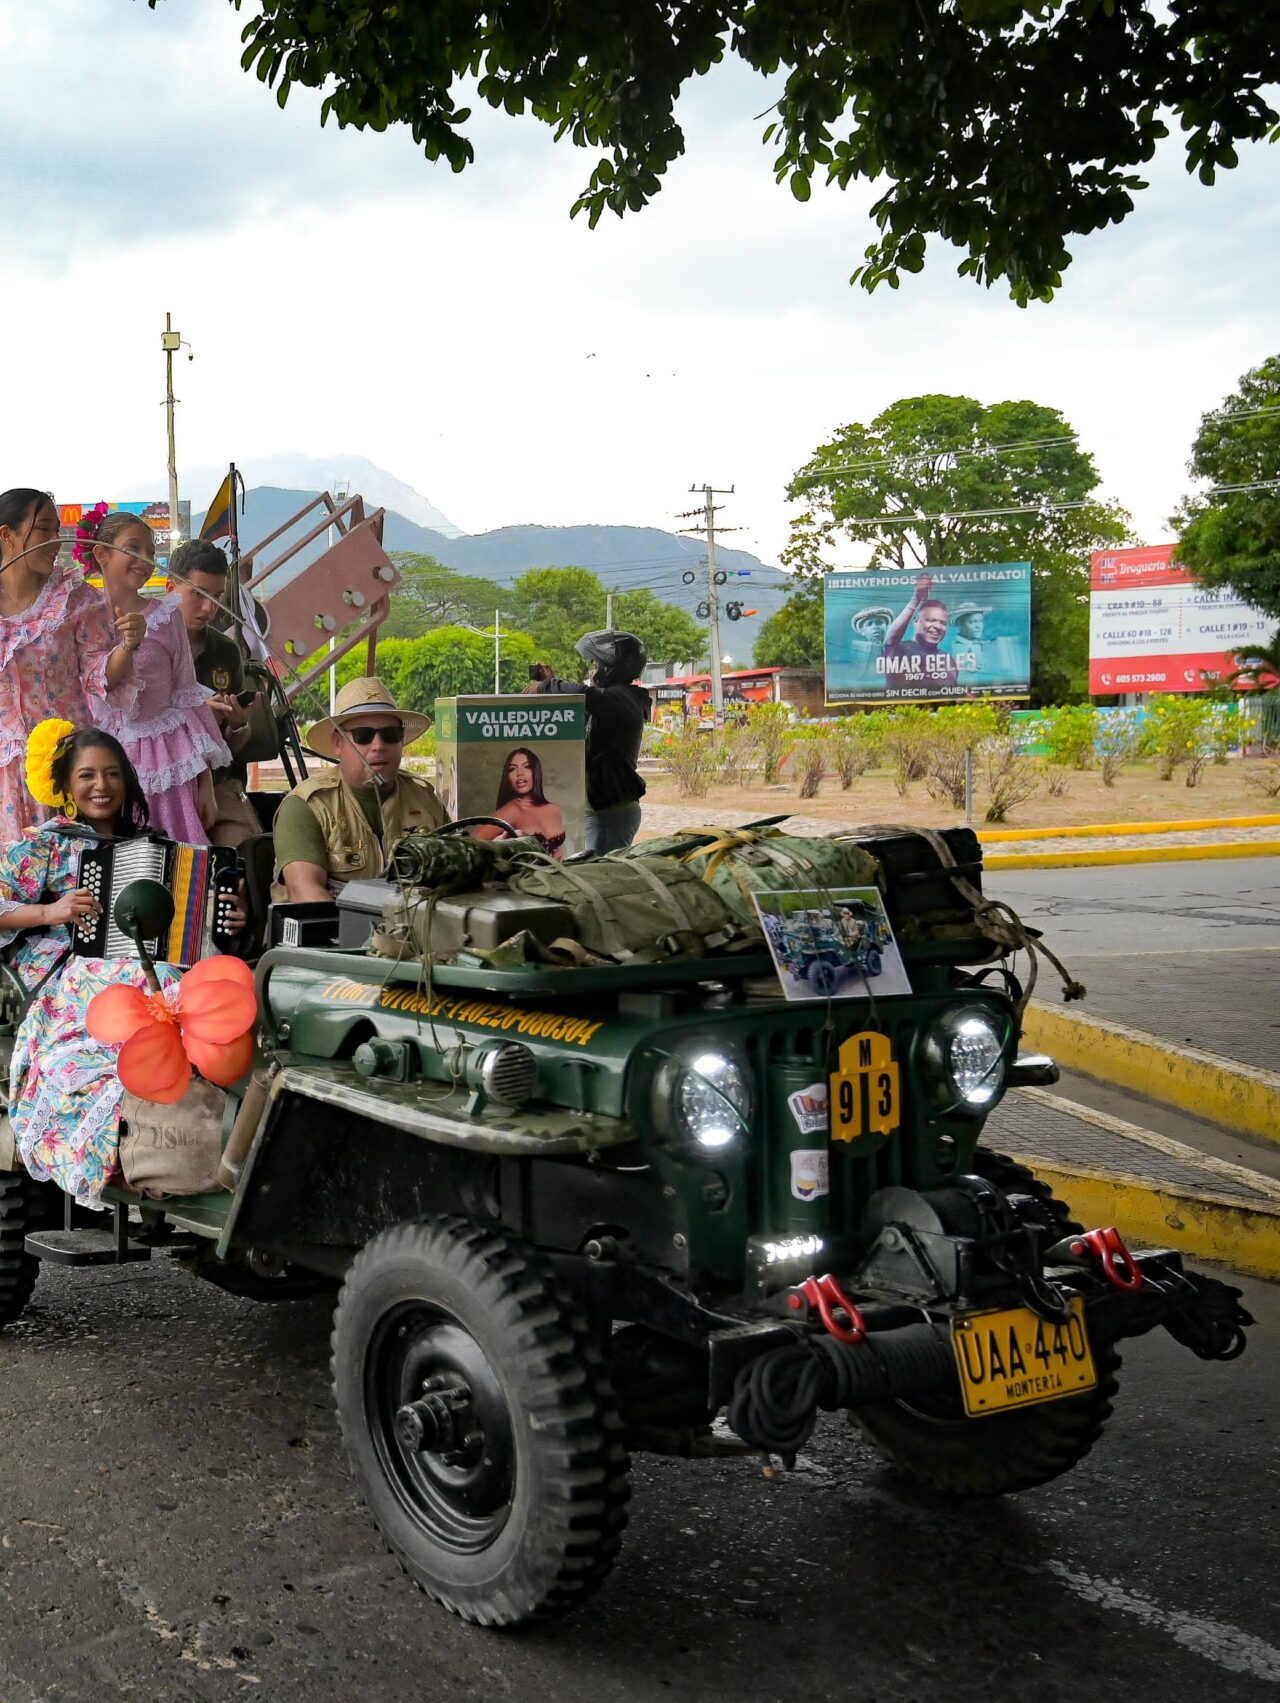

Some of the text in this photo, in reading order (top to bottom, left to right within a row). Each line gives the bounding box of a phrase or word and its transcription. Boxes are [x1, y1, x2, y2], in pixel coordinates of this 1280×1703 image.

[933, 574, 947, 584] AL
[948, 569, 1026, 583] VALLENATO!
[1200, 624, 1226, 633] CALLE
[1256, 622, 1265, 630] 13
[1103, 631, 1127, 640] CALLE
[875, 653, 977, 675] OMAR GELES
[904, 672, 925, 681] 1967
[885, 689, 900, 698] SIN
[901, 688, 928, 697] DECIR
[940, 686, 968, 696] QUIEN
[466, 710, 575, 724] VALLEDUPAR
[482, 724, 558, 737] 01 MAYO
[858, 1038, 872, 1067] M
[839, 1073, 892, 1124] 9 3
[959, 1311, 1086, 1385] UAA 440
[1005, 1374, 1063, 1400] MONTERIA
